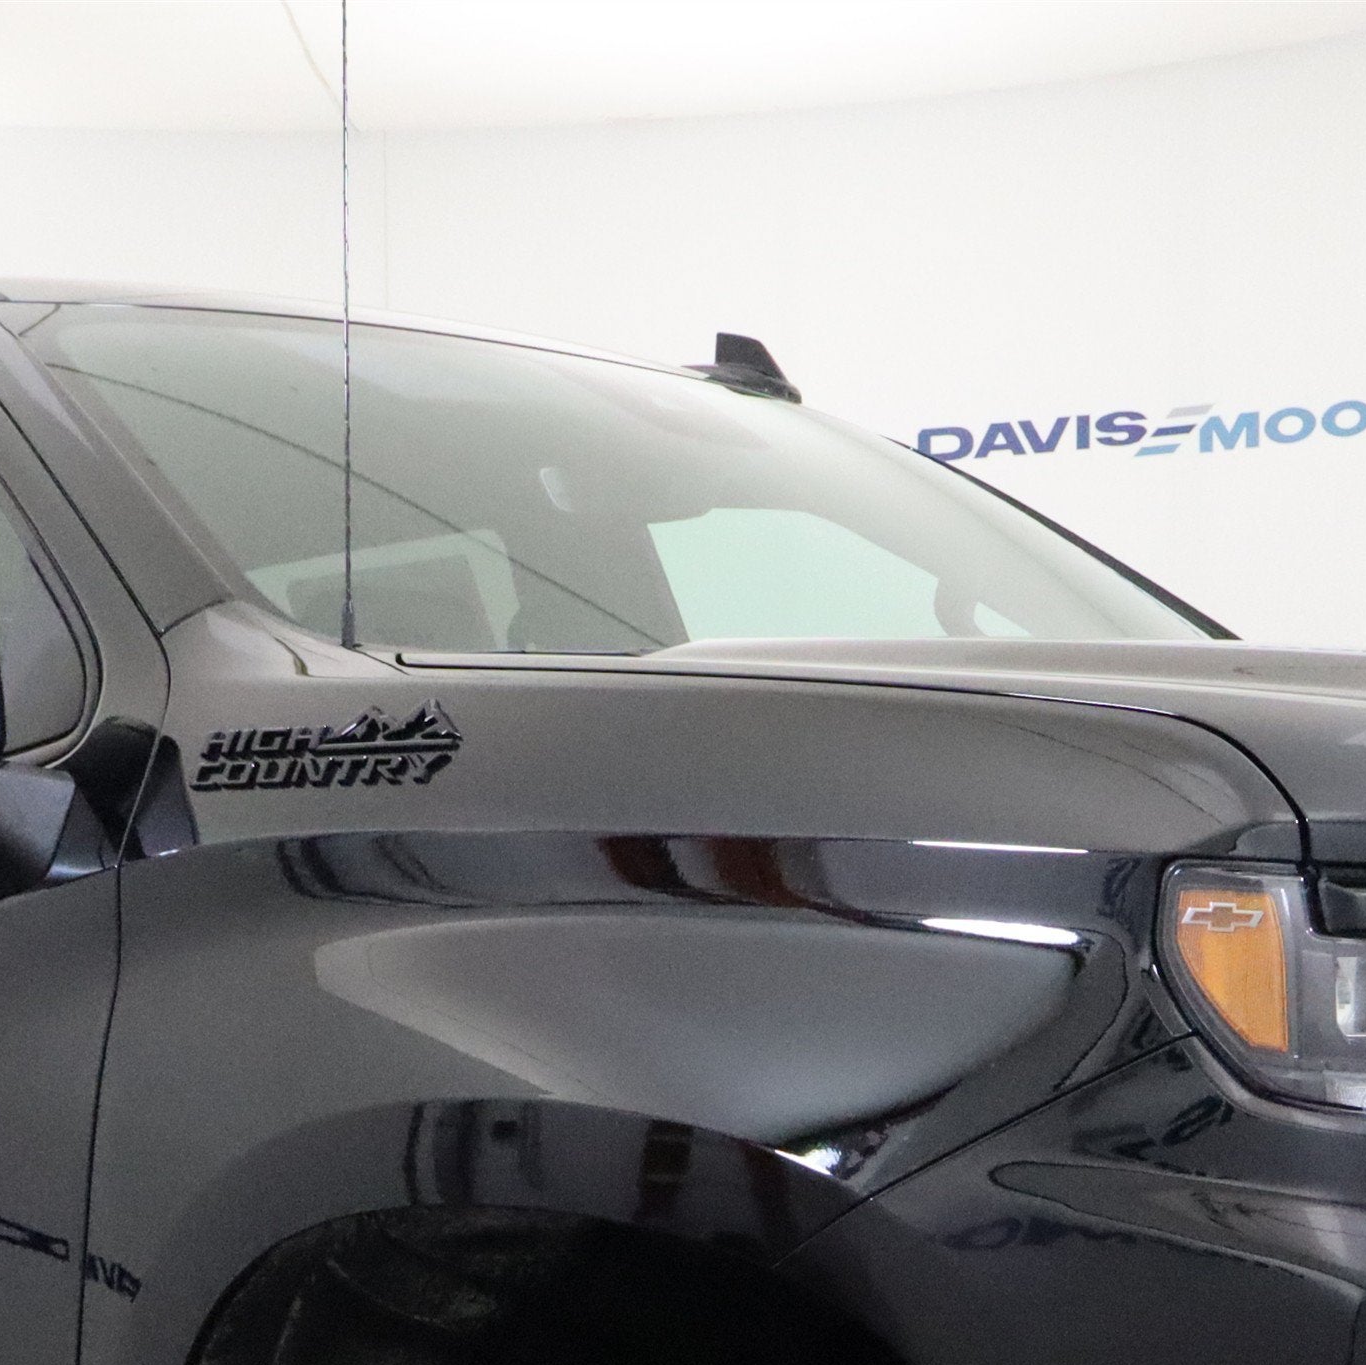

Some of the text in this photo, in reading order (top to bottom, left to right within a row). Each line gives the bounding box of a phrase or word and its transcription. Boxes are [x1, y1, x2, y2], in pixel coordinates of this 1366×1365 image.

[917, 410, 1147, 463] DAVIS
[200, 725, 333, 762] HIGH
[188, 752, 453, 793] COUNTRY
